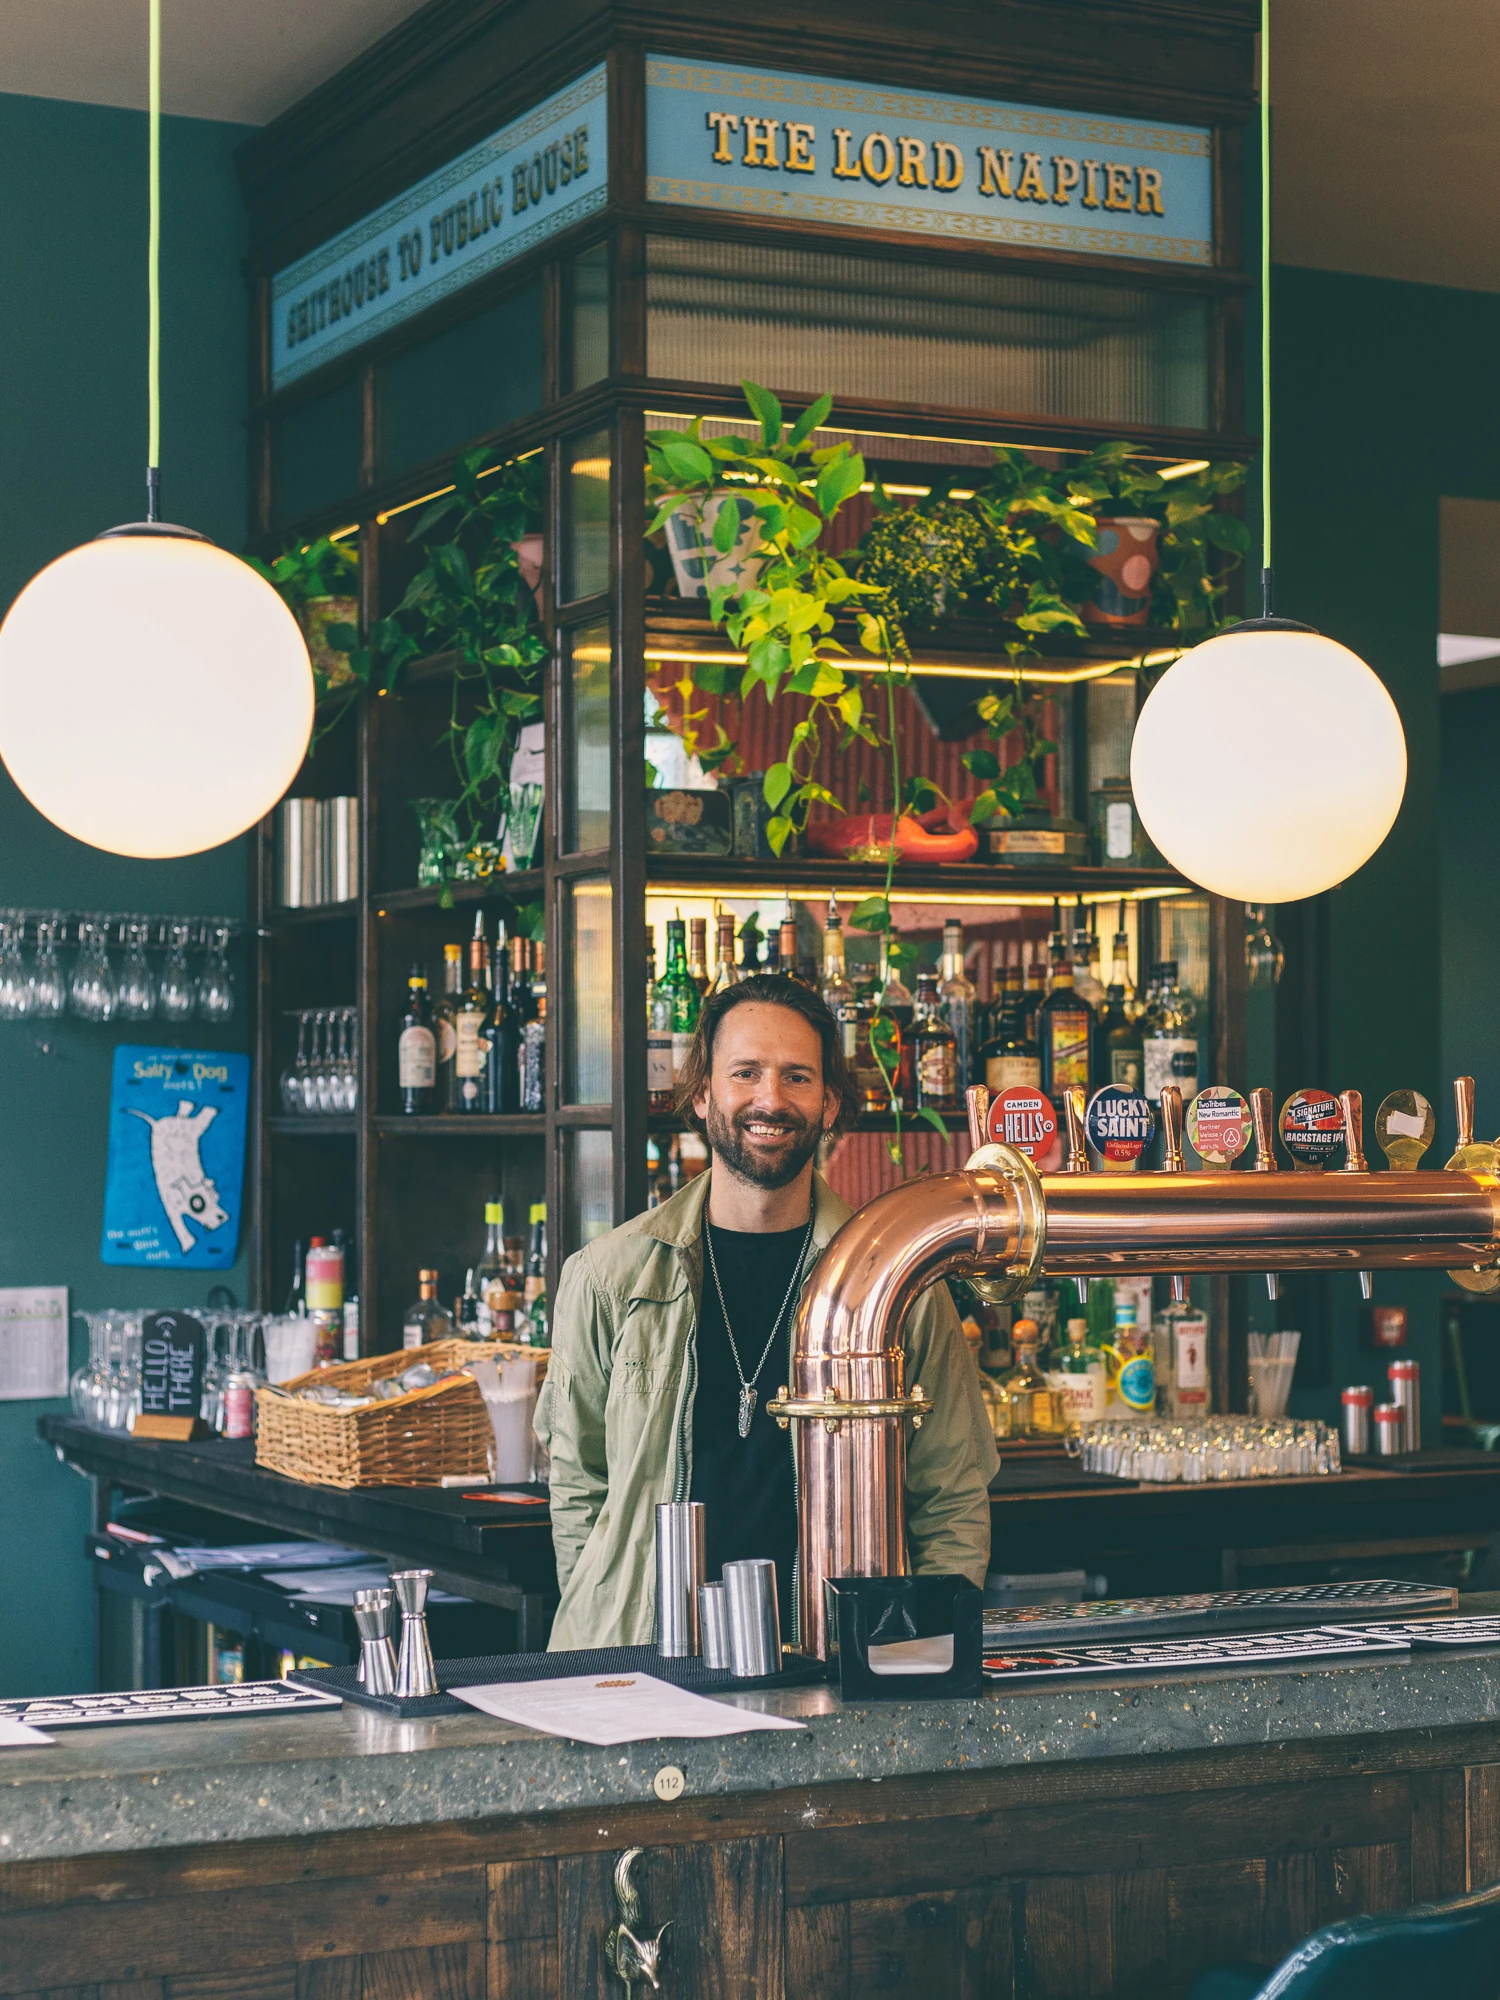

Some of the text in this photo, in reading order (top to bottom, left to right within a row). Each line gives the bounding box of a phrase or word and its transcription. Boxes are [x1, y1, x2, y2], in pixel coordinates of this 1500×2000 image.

[707, 110, 1166, 217] THE LORD NAPIER
[287, 122, 590, 348] SHITHOUSE TO PUBLIC HOUSE
[134, 1060, 228, 1083] Salty Dog
[1006, 1101, 1039, 1109] CAMDEN
[1097, 1099, 1148, 1117] LUCKY
[1211, 1110, 1239, 1118] Romantic
[1296, 1101, 1334, 1118] SIGNATURE
[1004, 1112, 1044, 1143] HELLS
[1097, 1117, 1149, 1138] SAINT
[1286, 1132, 1332, 1143] BACKSTAGE
[1114, 1149, 1131, 1157] 0.5%
[143, 1339, 168, 1410] HELLO
[168, 1341, 194, 1412] THERE
[1086, 1633, 1335, 1657] CAMDEN
[660, 1777, 679, 1790] 112
